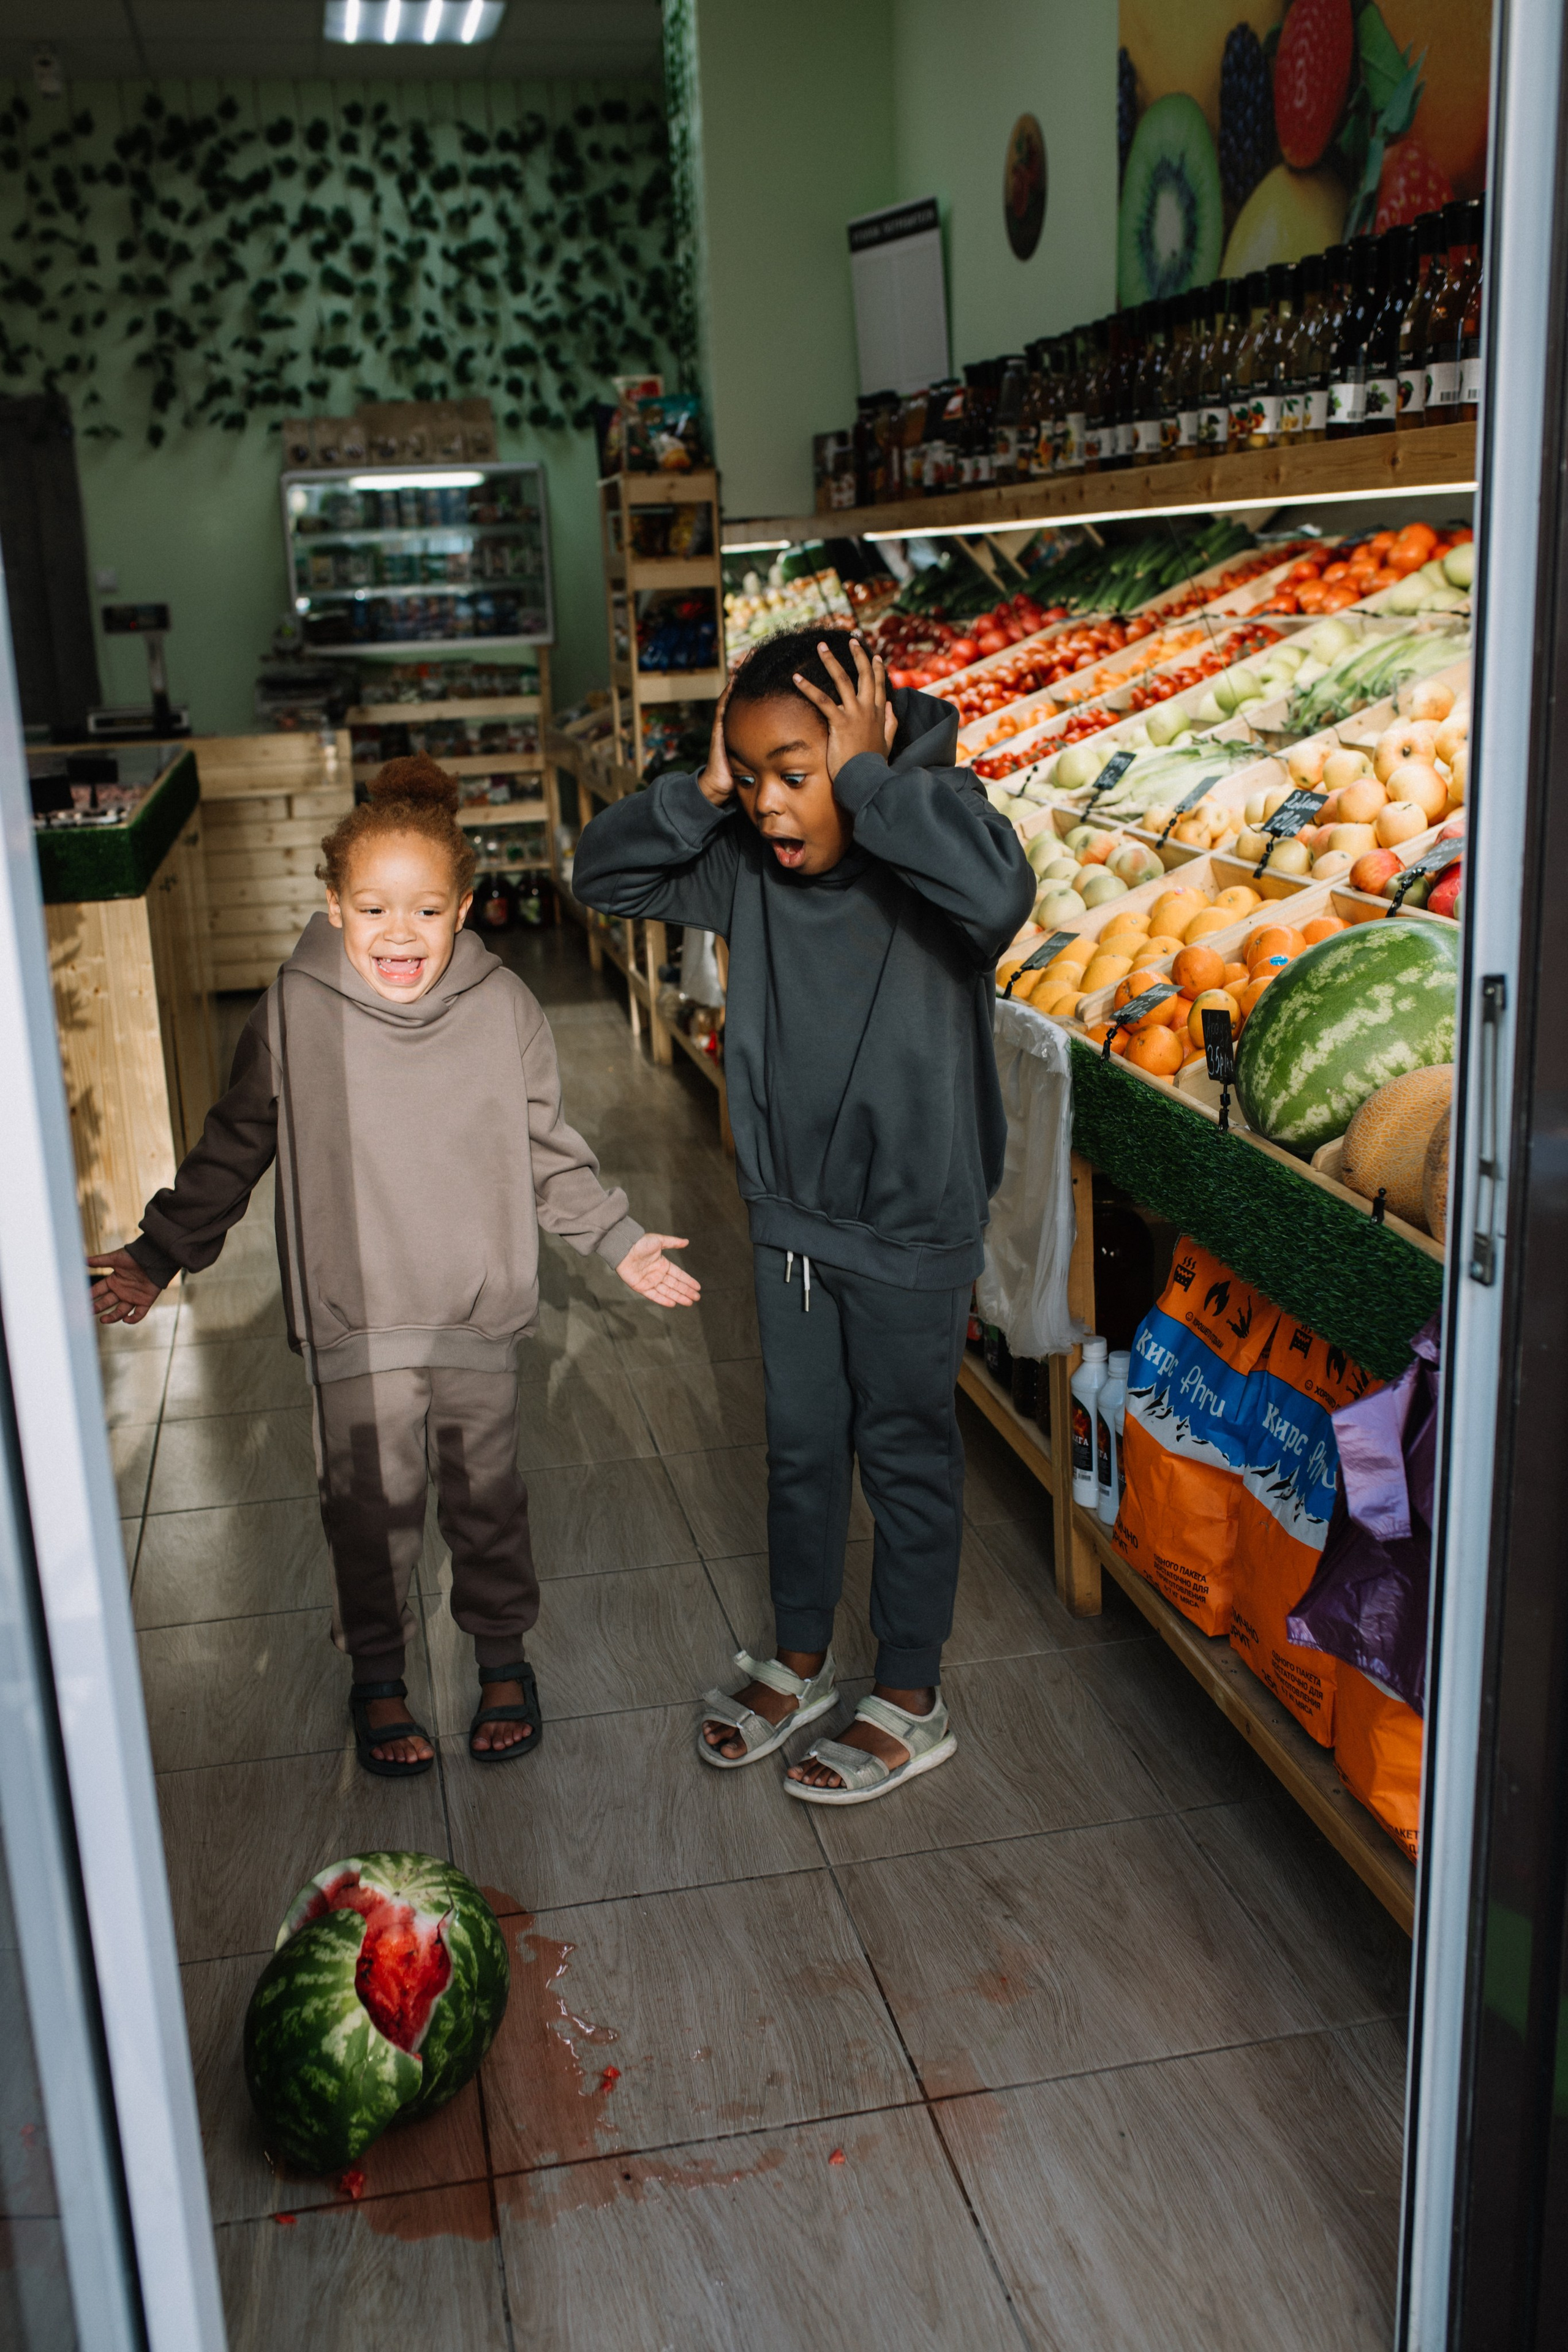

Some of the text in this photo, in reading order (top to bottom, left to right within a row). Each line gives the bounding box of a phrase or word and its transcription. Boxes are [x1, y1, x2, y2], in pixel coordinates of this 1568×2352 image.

[1135, 1328, 1179, 1378] Кирс
[1262, 1401, 1309, 1456] Кирс
[1180, 1566, 1207, 1583] ПАКЕТА
[1193, 1583, 1209, 1594] ДЛЯ
[1180, 1595, 1199, 1608] МЯСА
[1272, 1649, 1321, 1688] ОДНОГО ПАКЕТА
[1309, 1686, 1324, 1700] ДЛЯ
